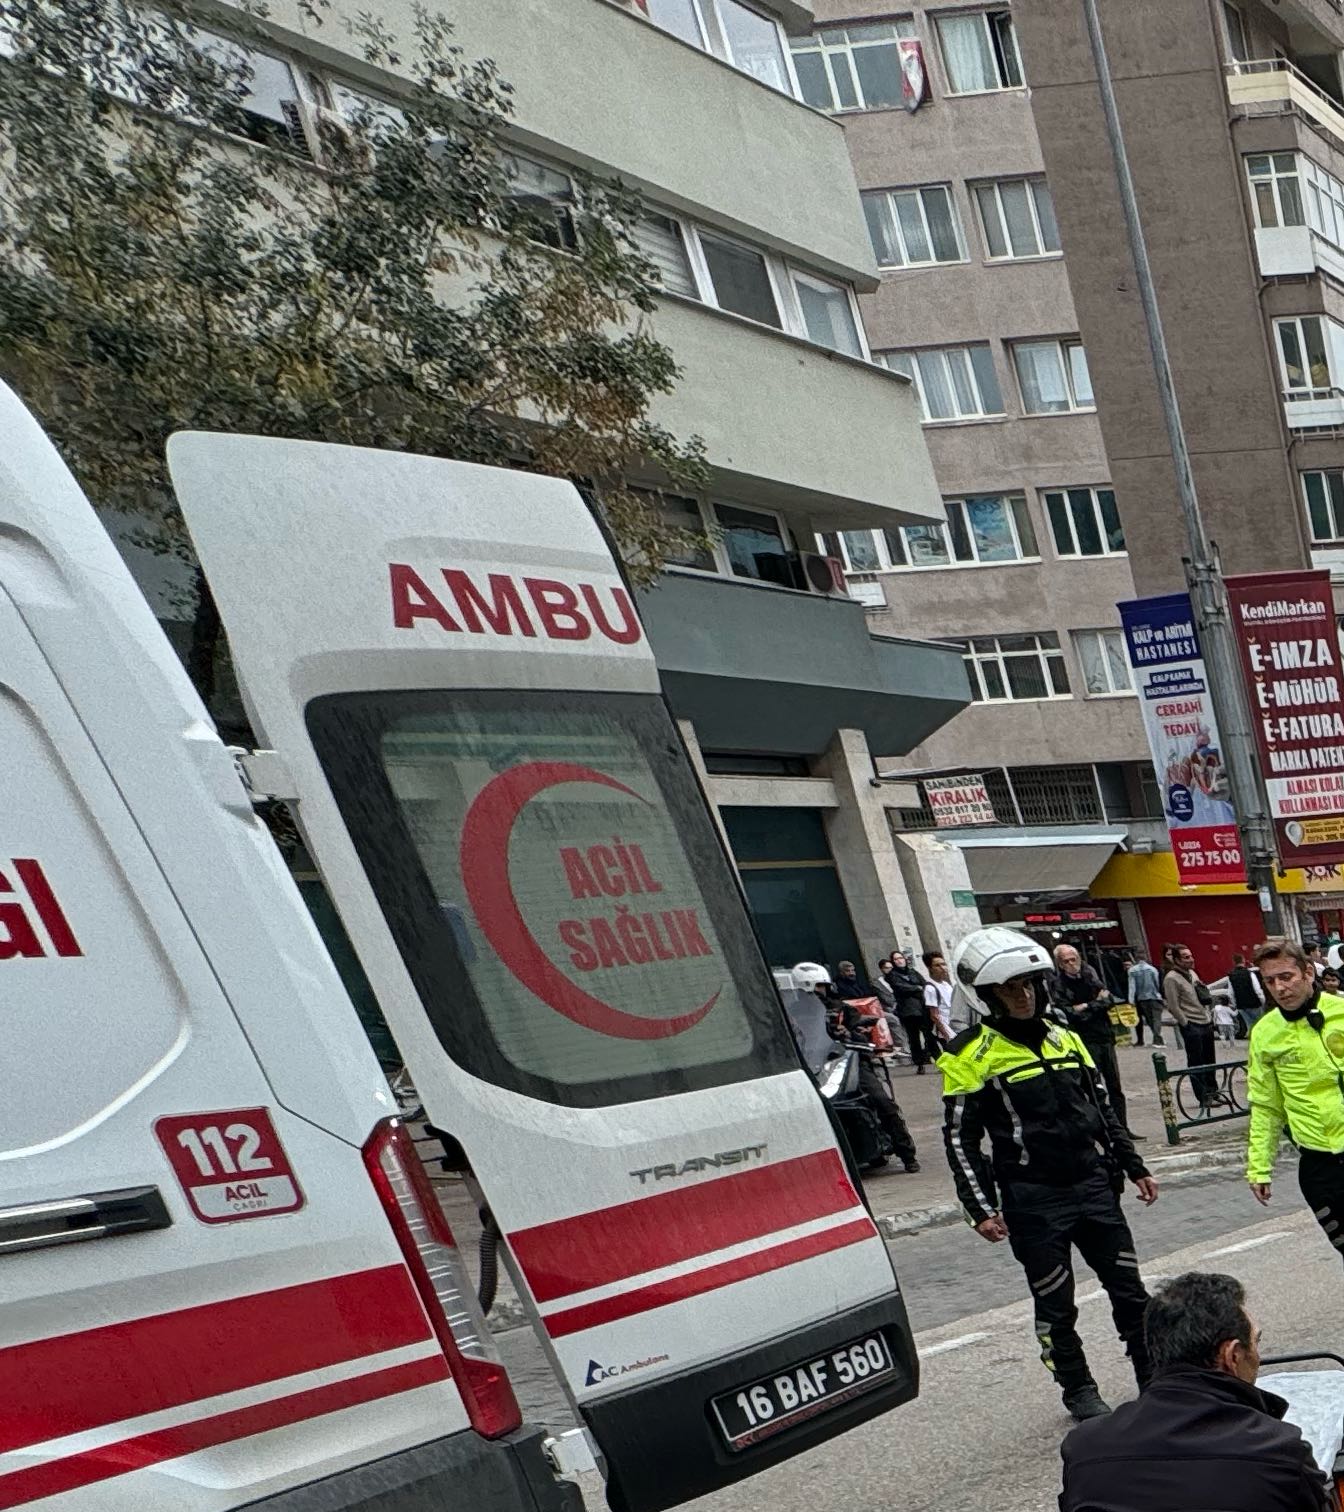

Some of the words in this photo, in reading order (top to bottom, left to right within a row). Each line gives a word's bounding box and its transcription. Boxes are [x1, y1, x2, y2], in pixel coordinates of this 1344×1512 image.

[389, 563, 642, 645] AMBU
[1132, 628, 1153, 644] KALP
[559, 834, 664, 899] ACİL
[558, 904, 714, 972] SAĞLIK
[177, 1123, 274, 1176] 112
[629, 1143, 768, 1184] TRANSIT
[737, 1385, 775, 1425] 16
[774, 1359, 828, 1410] BAF
[831, 1338, 885, 1384] 560
